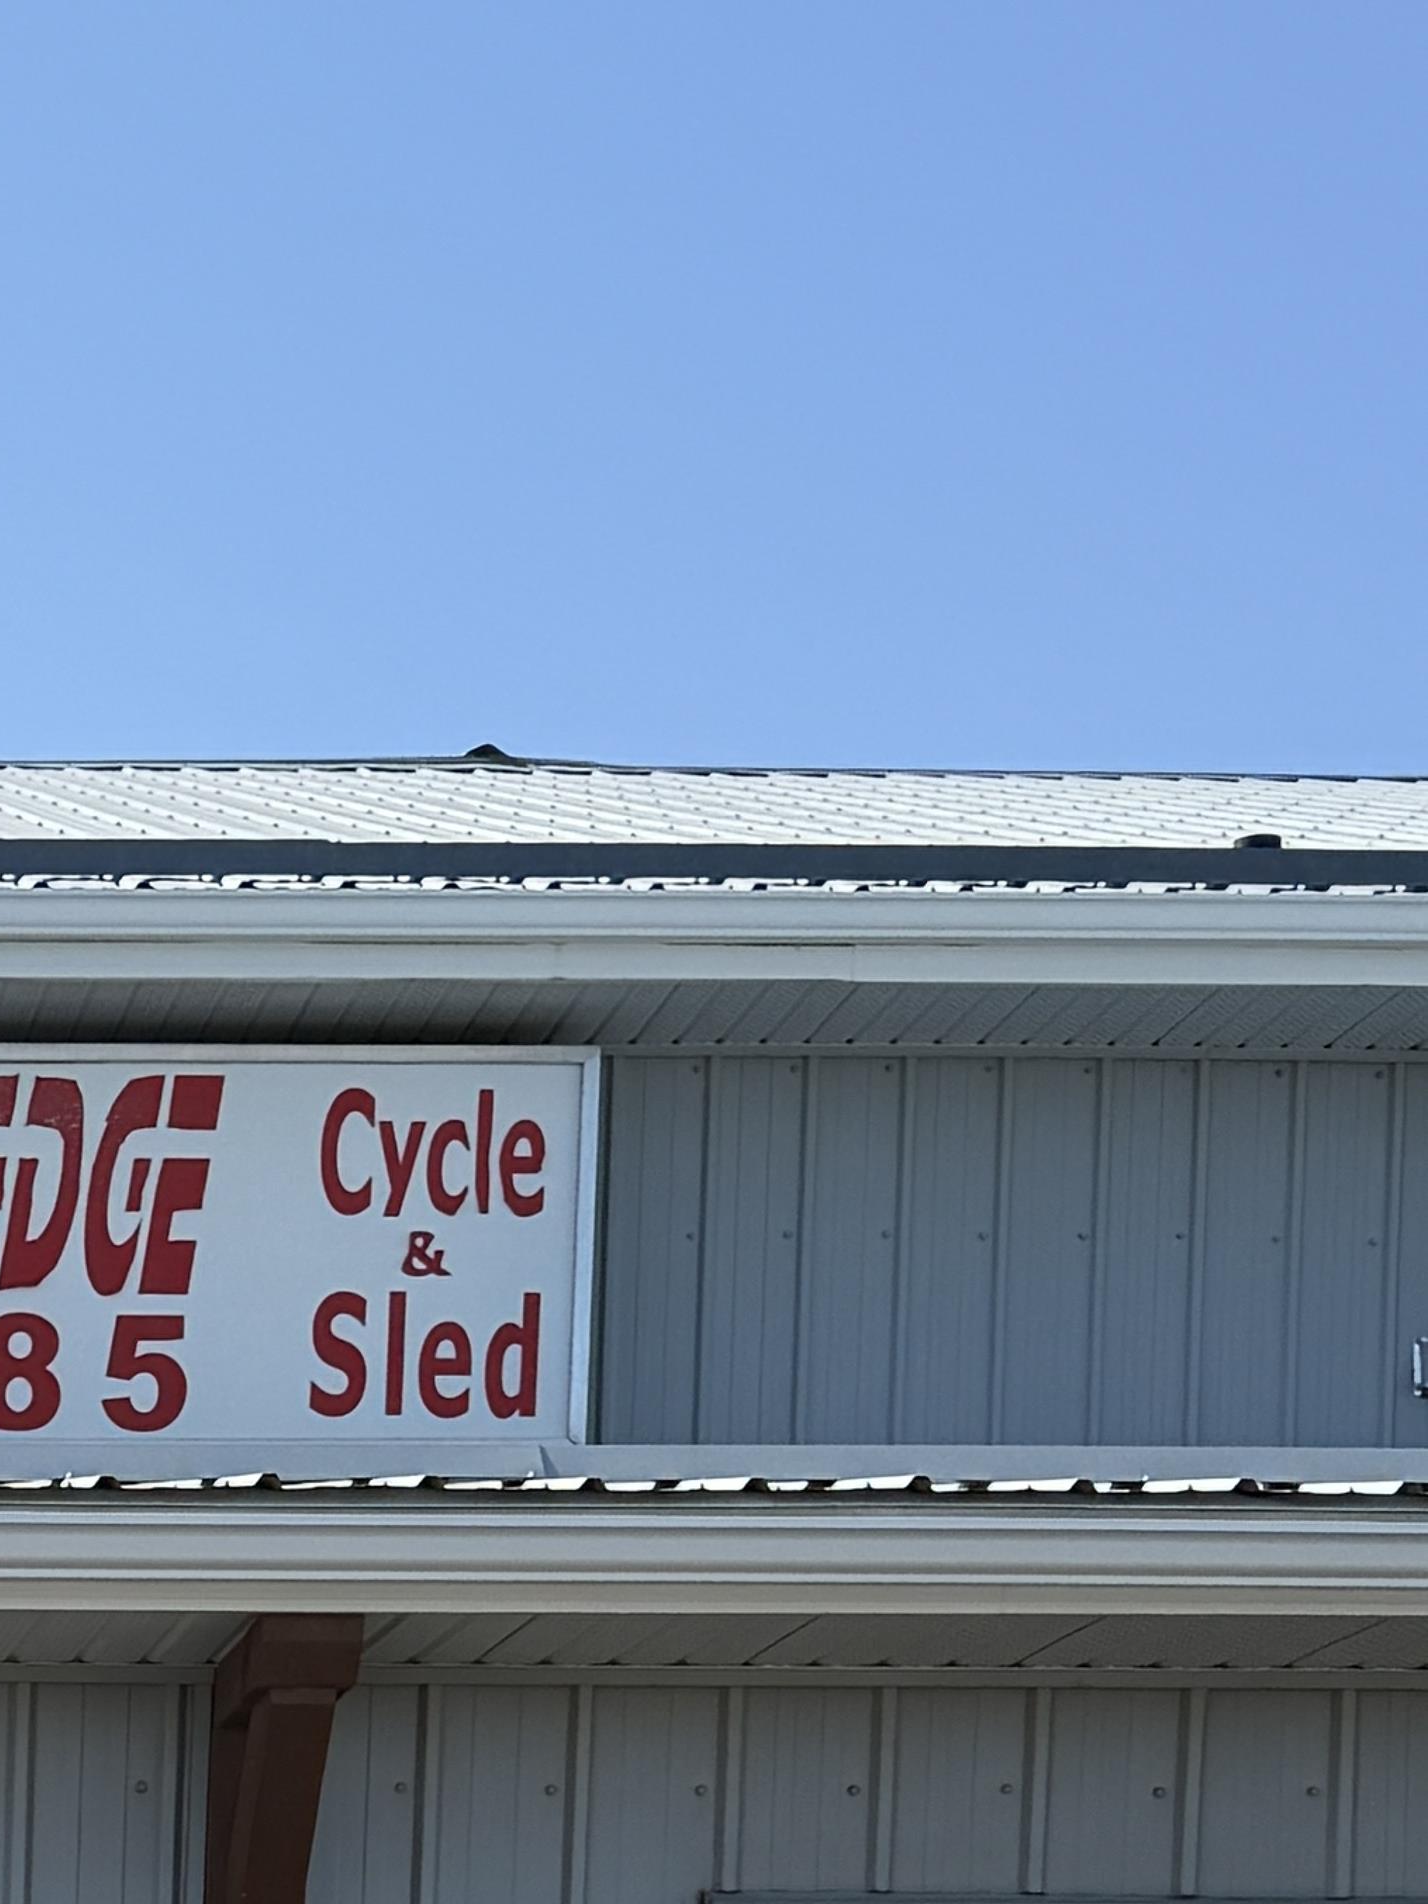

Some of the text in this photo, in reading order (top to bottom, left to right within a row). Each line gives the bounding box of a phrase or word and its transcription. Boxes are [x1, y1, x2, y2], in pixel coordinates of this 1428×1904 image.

[320, 1088, 547, 1218] Cycle
[400, 1230, 451, 1278] &
[309, 1290, 540, 1419] Sled
